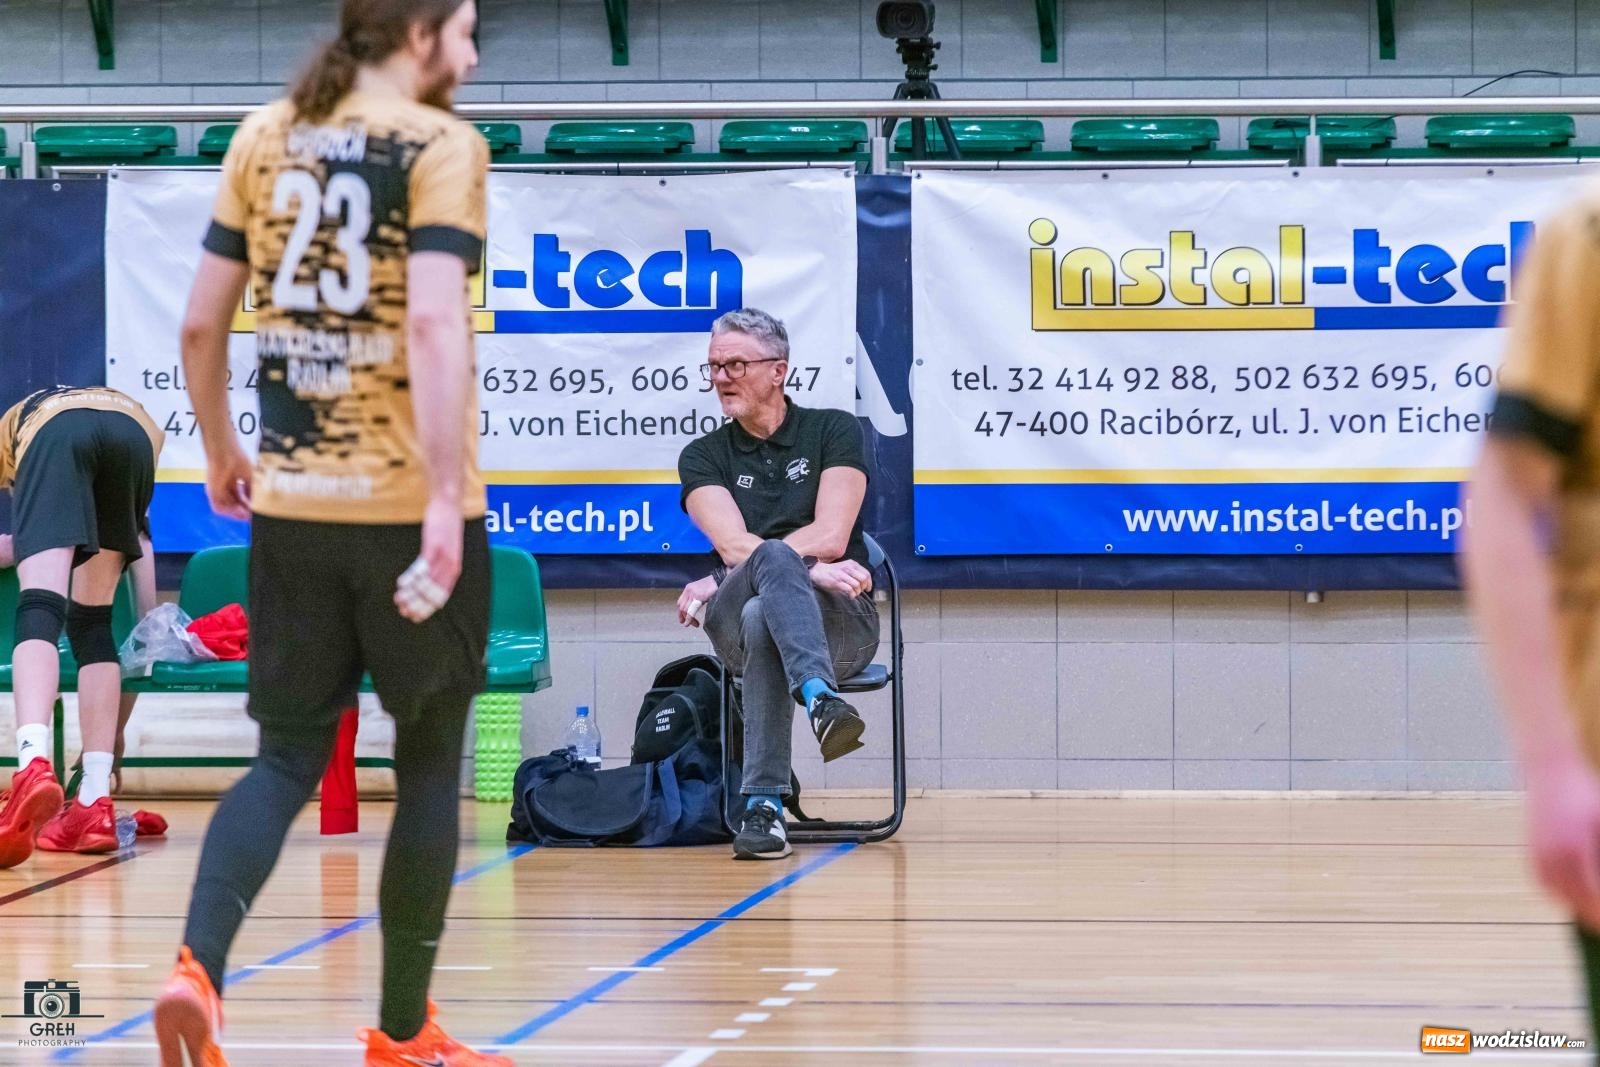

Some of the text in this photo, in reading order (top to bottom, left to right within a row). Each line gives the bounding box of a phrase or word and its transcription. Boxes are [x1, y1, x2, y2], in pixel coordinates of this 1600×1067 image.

[272, 170, 371, 315] 23
[142, 365, 187, 391] tel.
[483, 366, 538, 393] 632
[549, 366, 614, 395] 695,
[631, 365, 688, 392] 606
[951, 364, 998, 391] tel.
[1007, 367, 1044, 393] 32
[1055, 367, 1114, 392] 414
[1123, 367, 1160, 393] 92
[1171, 365, 1217, 394] 88,
[1234, 366, 1291, 392] 502
[1303, 364, 1360, 391] 632
[1371, 363, 1436, 392] 695,
[479, 409, 733, 436] J. von Eichendor
[974, 410, 1089, 437] 47-400
[1100, 408, 1241, 438] Racibórz,
[1252, 407, 1288, 434] ul.
[1298, 408, 1319, 434] J.
[1329, 413, 1387, 434] von
